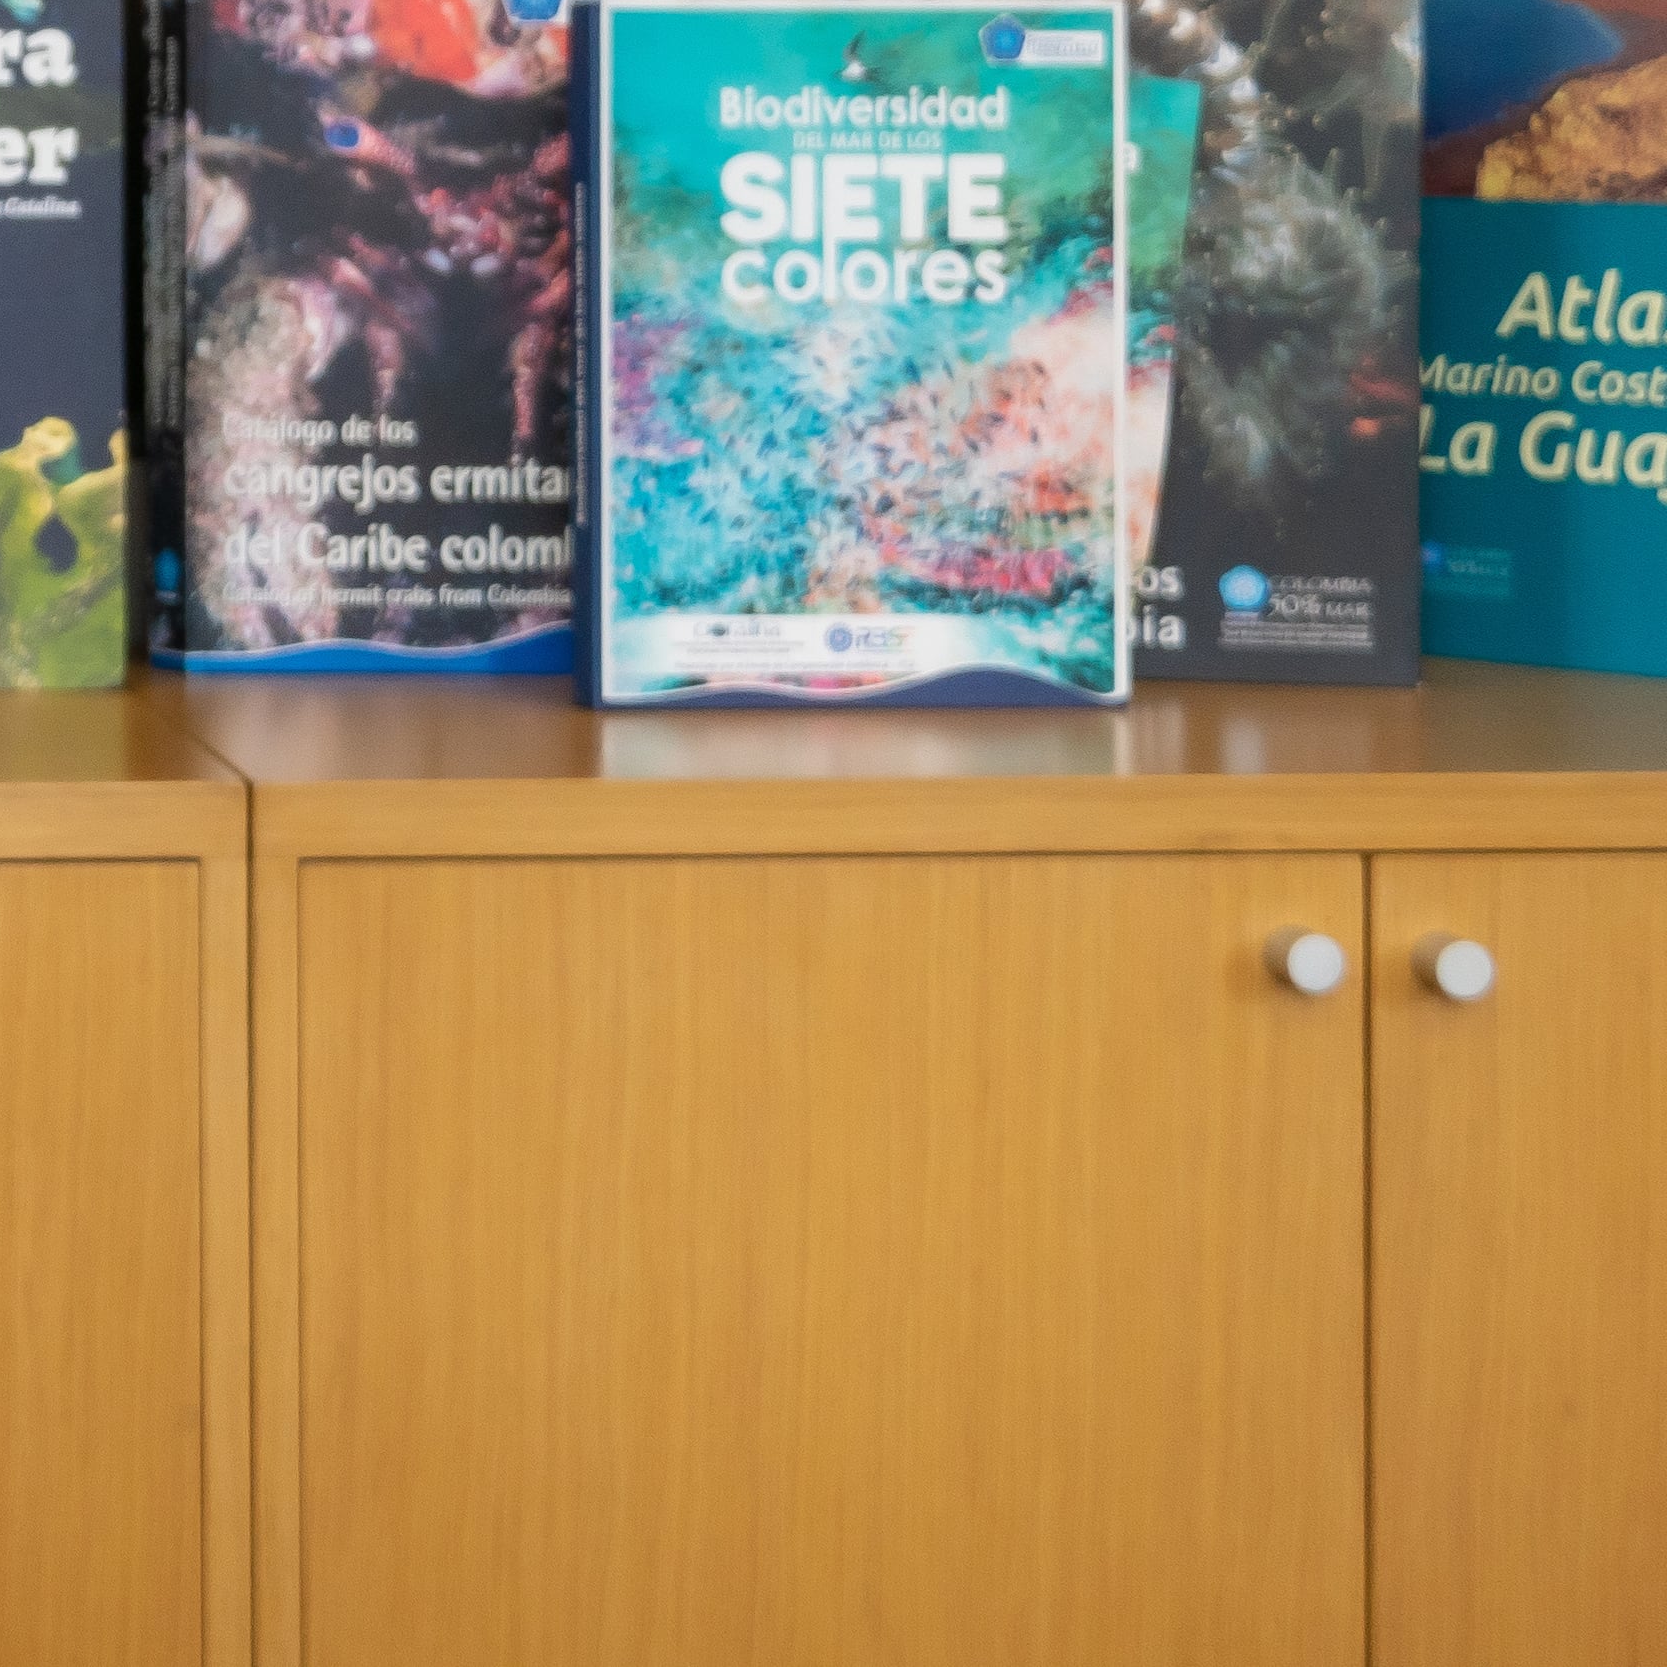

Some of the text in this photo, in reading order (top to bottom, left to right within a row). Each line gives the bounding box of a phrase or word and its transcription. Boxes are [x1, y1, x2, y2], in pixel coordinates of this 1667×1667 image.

[720, 85, 1009, 129] Biodiversidad
[793, 132, 942, 149] DEL MAR DE LOS
[720, 151, 1009, 243] SIETE
[721, 246, 1007, 305] colores
[1495, 268, 1667, 346] Atla
[1419, 353, 1667, 407] Marino Cost
[341, 413, 371, 446] de
[379, 413, 417, 446] los
[1419, 404, 1667, 505] La Gua
[224, 453, 572, 515] cangrejos ermita
[224, 523, 282, 566] del
[299, 521, 431, 574] Caribe
